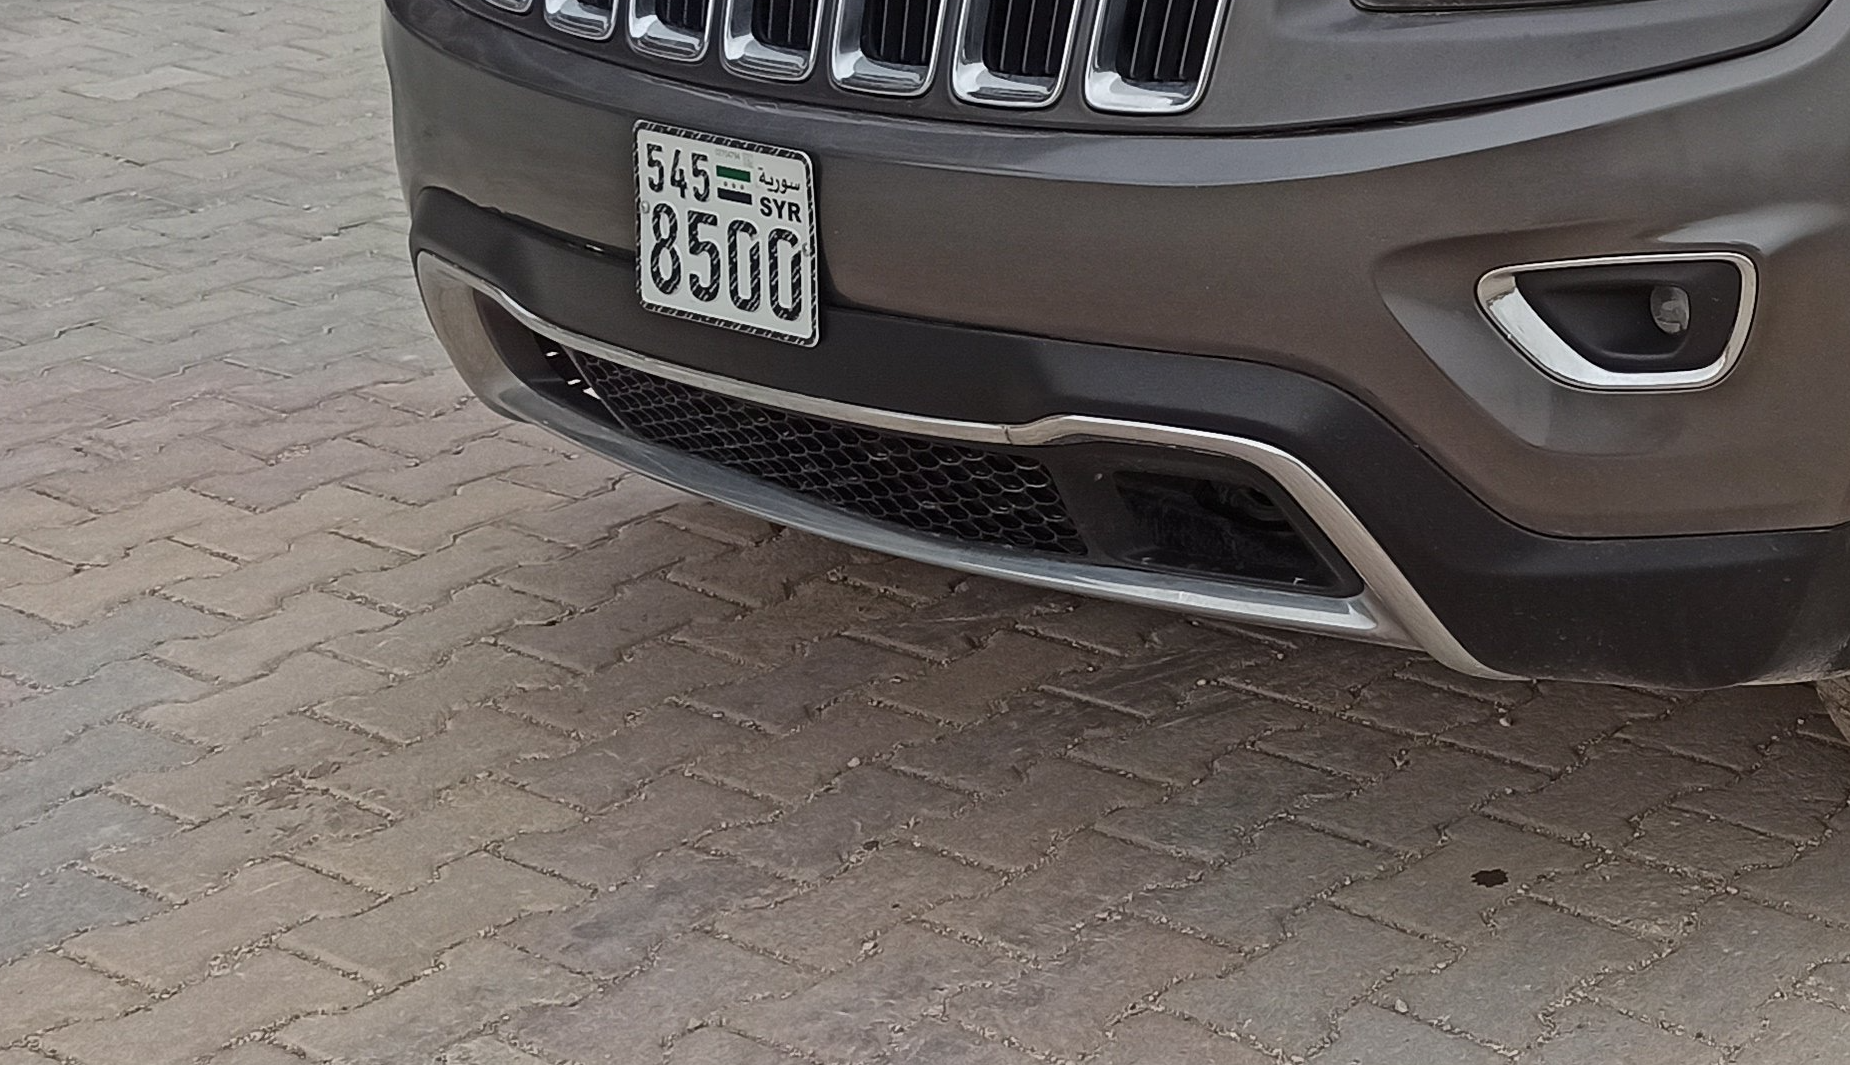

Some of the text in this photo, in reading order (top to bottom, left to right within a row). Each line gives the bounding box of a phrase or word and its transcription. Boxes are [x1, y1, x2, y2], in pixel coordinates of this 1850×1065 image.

[646, 142, 711, 202] 545
[757, 166, 801, 195] سورية
[759, 196, 802, 224] SYR
[650, 202, 802, 322] 8500
